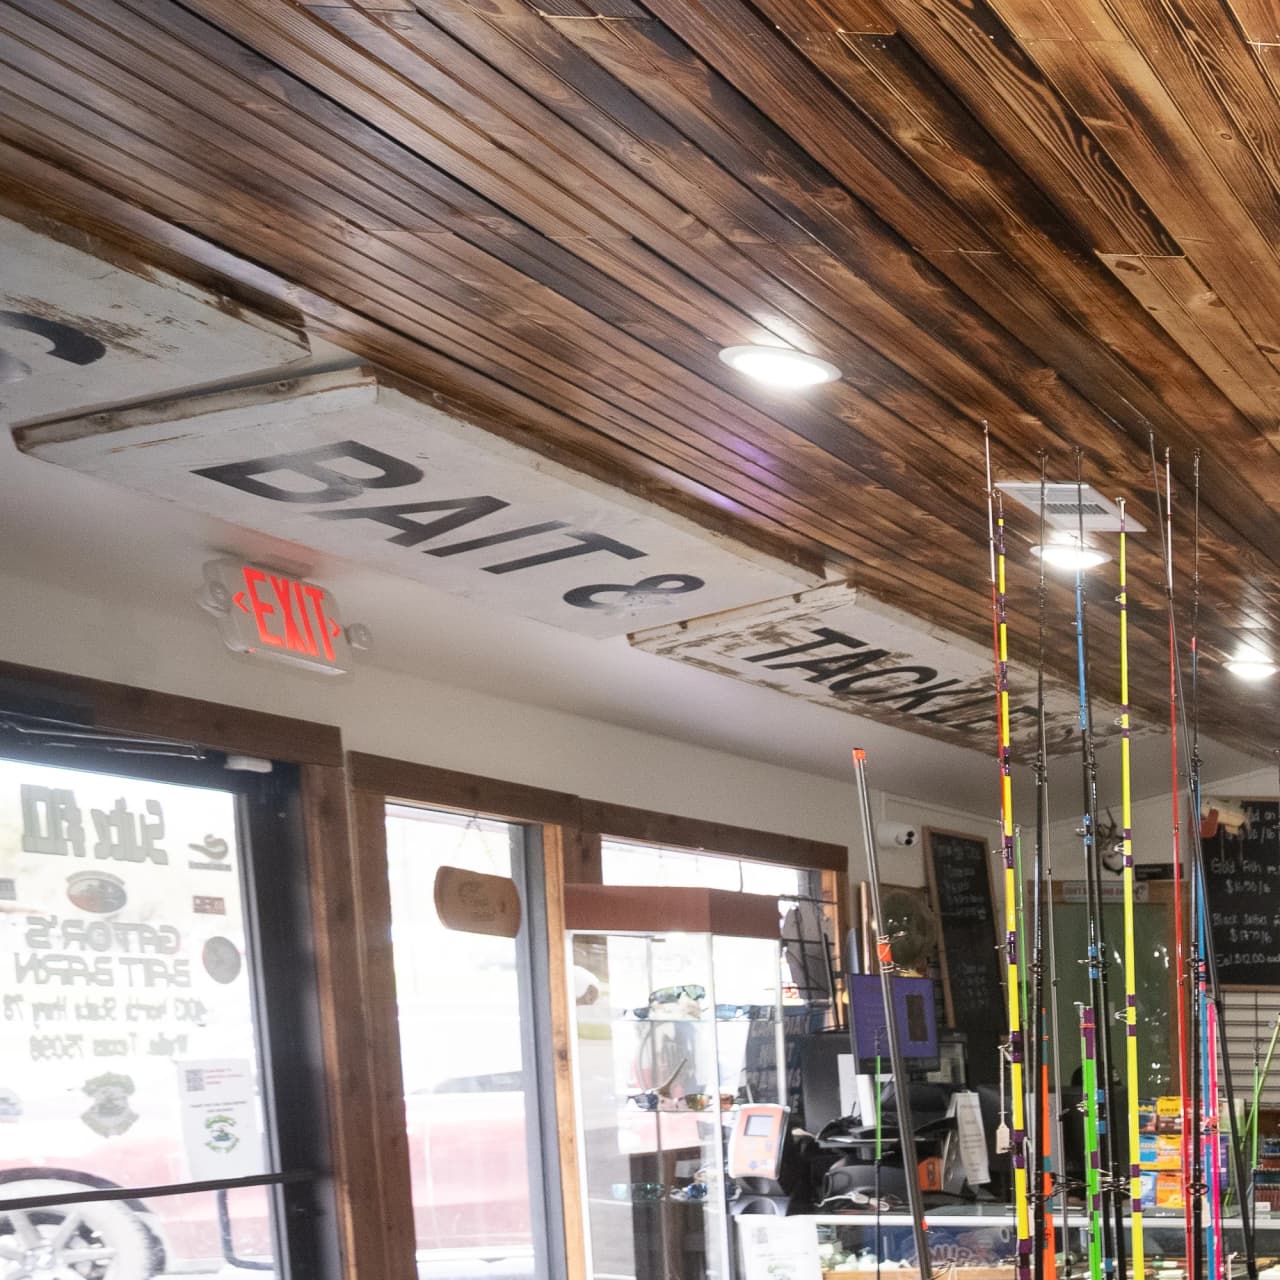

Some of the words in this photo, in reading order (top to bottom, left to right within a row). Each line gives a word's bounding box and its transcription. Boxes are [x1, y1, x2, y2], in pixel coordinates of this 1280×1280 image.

[189, 440, 648, 575] BAIT
[562, 572, 706, 610] &
[242, 566, 336, 661] EXIT
[741, 627, 1050, 731] TACKLE
